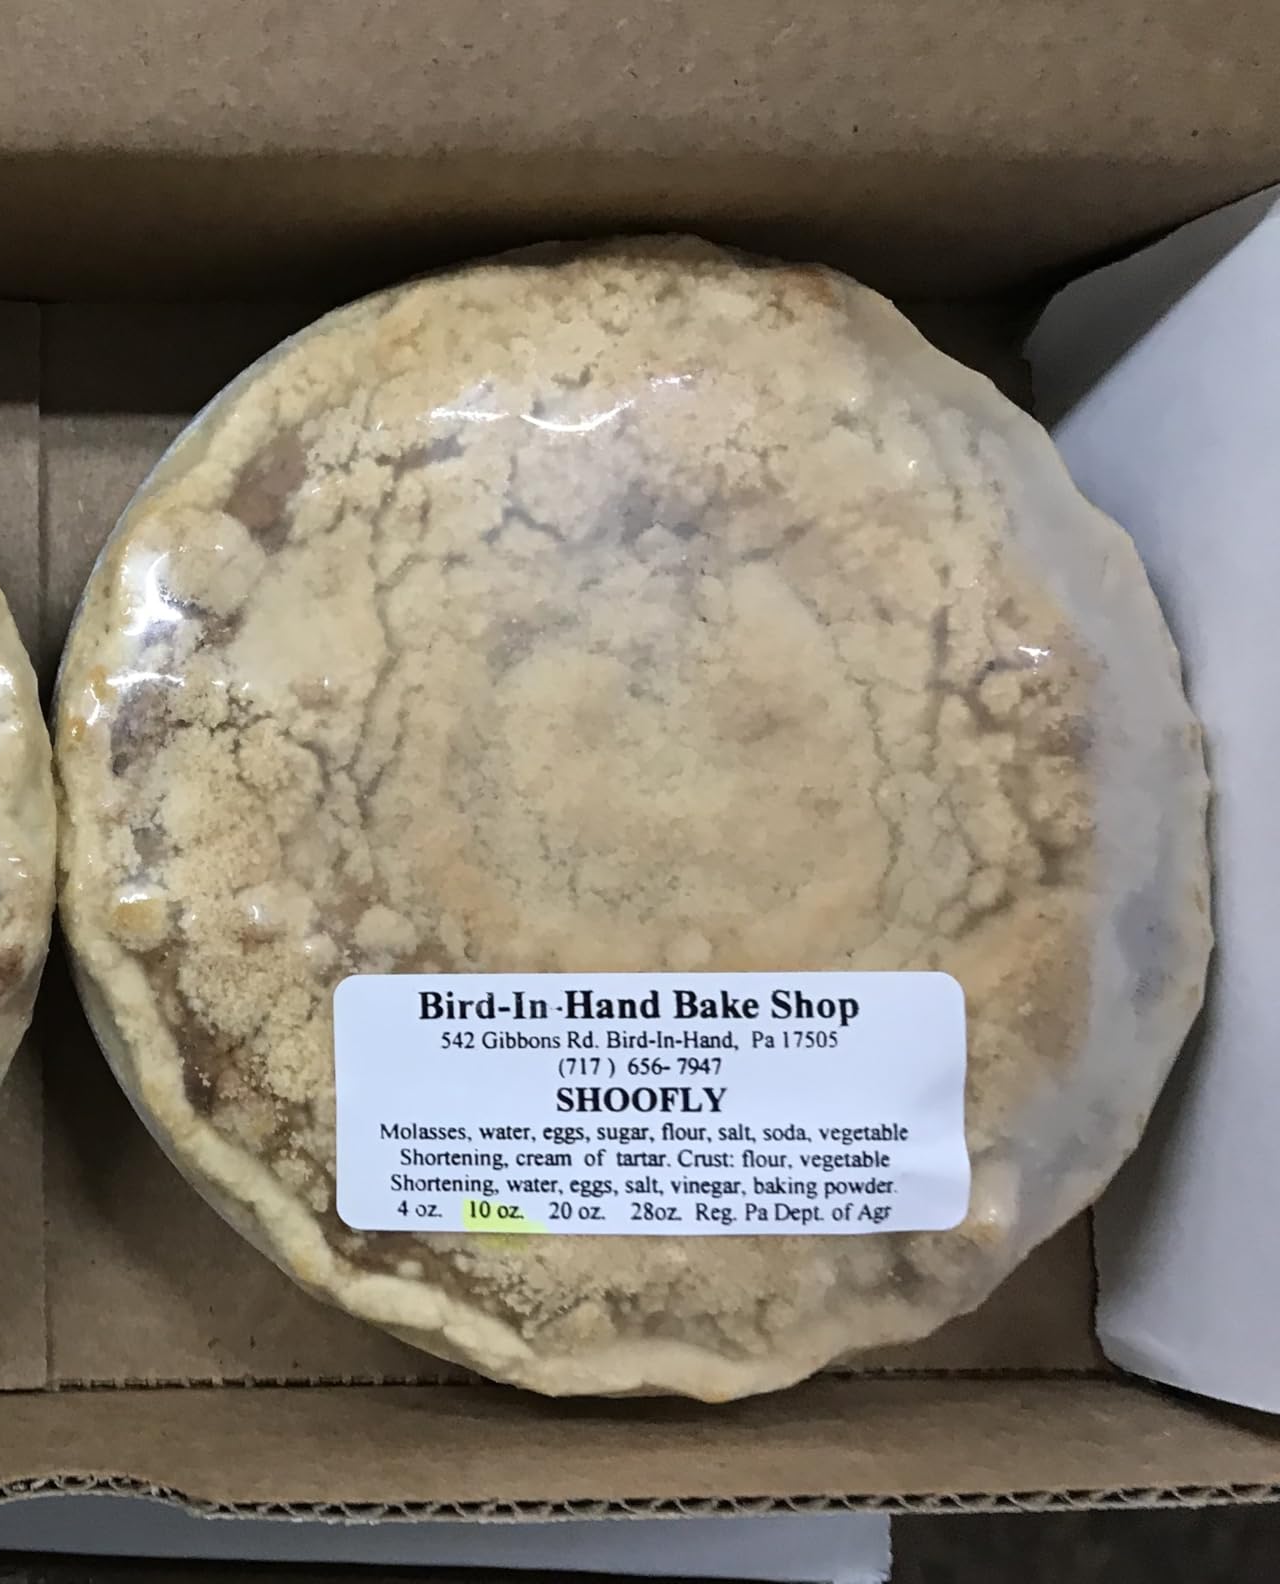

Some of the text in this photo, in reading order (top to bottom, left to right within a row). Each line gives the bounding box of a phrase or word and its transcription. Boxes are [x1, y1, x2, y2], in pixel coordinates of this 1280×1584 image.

[672, 989, 760, 1020] Bake
[770, 989, 860, 1027] Shop
[441, 1030, 838, 1051] 542 Gibbons Rd. Bird-In-Hand, Pa 17505
[556, 1086, 727, 1113] SHOOFLY
[380, 1122, 909, 1146] Molasses, water, eggs, sugar, flour, salt, soda, vegetable
[400, 1148, 890, 1173] Shortening, cream of tartar. Crust: flour, vegetable
[390, 1173, 898, 1200] Shortening, water, eggs, salt, vinegar, baking powder.
[397, 1199, 893, 1226] 4 oz. 10 oz. 20 oz. 28oz. Reg. Pa Dept. of Agr
